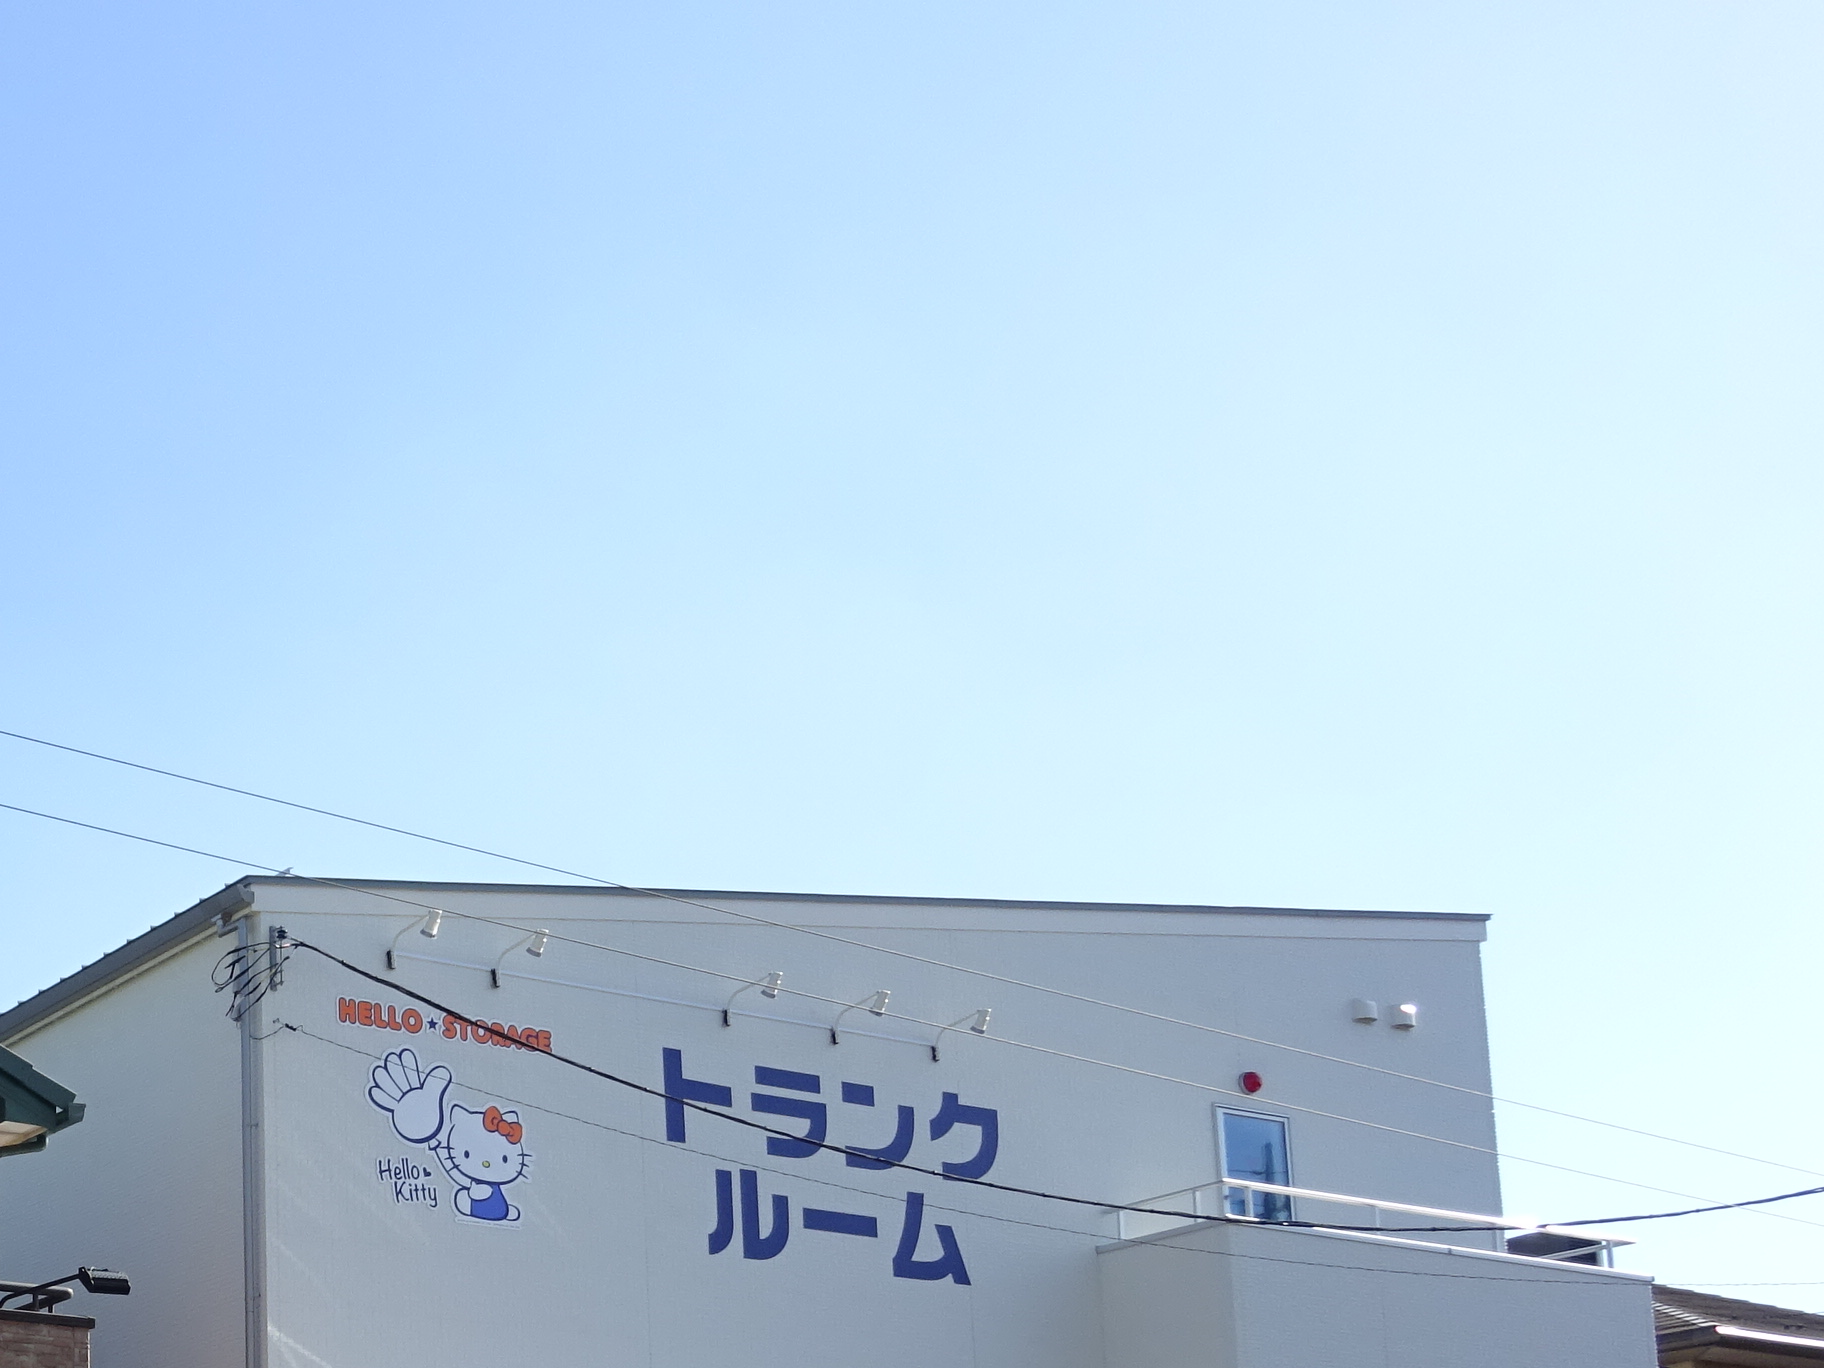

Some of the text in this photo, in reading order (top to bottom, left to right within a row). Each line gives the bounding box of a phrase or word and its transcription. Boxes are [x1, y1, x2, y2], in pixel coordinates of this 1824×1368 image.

[338, 997, 553, 1053] HELLO STORAGE
[662, 1047, 999, 1182] トランク
[378, 1157, 420, 1181] Hello
[394, 1181, 438, 1208] Kitty
[708, 1168, 973, 1286] ルーム
